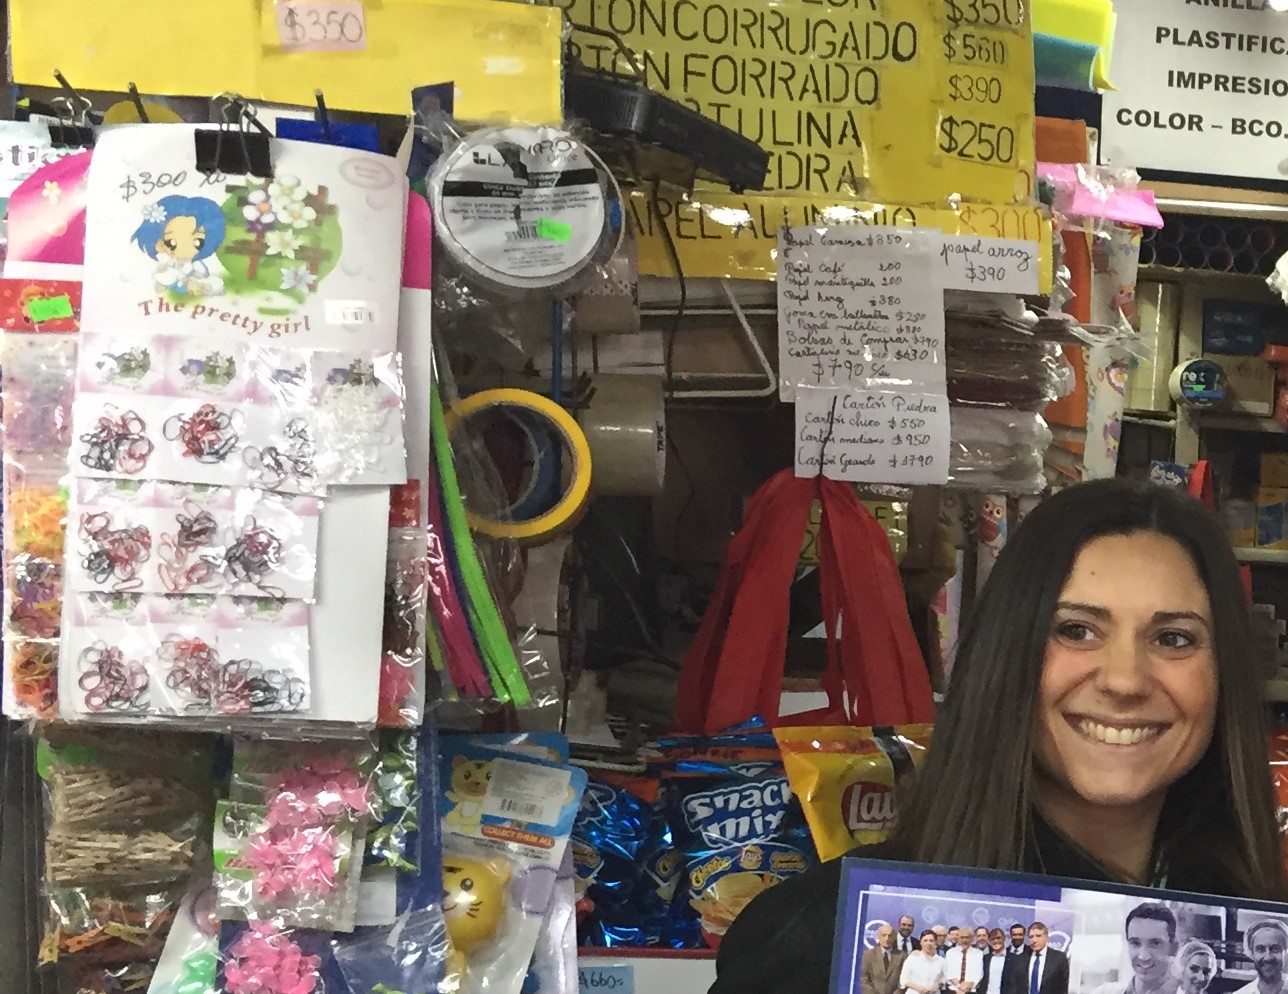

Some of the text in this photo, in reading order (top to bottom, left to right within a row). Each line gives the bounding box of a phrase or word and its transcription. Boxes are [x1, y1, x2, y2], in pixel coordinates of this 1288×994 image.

[284, 6, 364, 44] $350
[683, 53, 879, 105] FORRADO
[949, 74, 1002, 103] $390
[1116, 108, 1204, 132] COLOR
[939, 115, 1014, 162] $250
[119, 170, 188, 202] $300
[941, 240, 1032, 271] papel arroz
[966, 261, 1005, 282] $390
[138, 297, 311, 339] The pretty girl
[707, 809, 785, 841] mix
